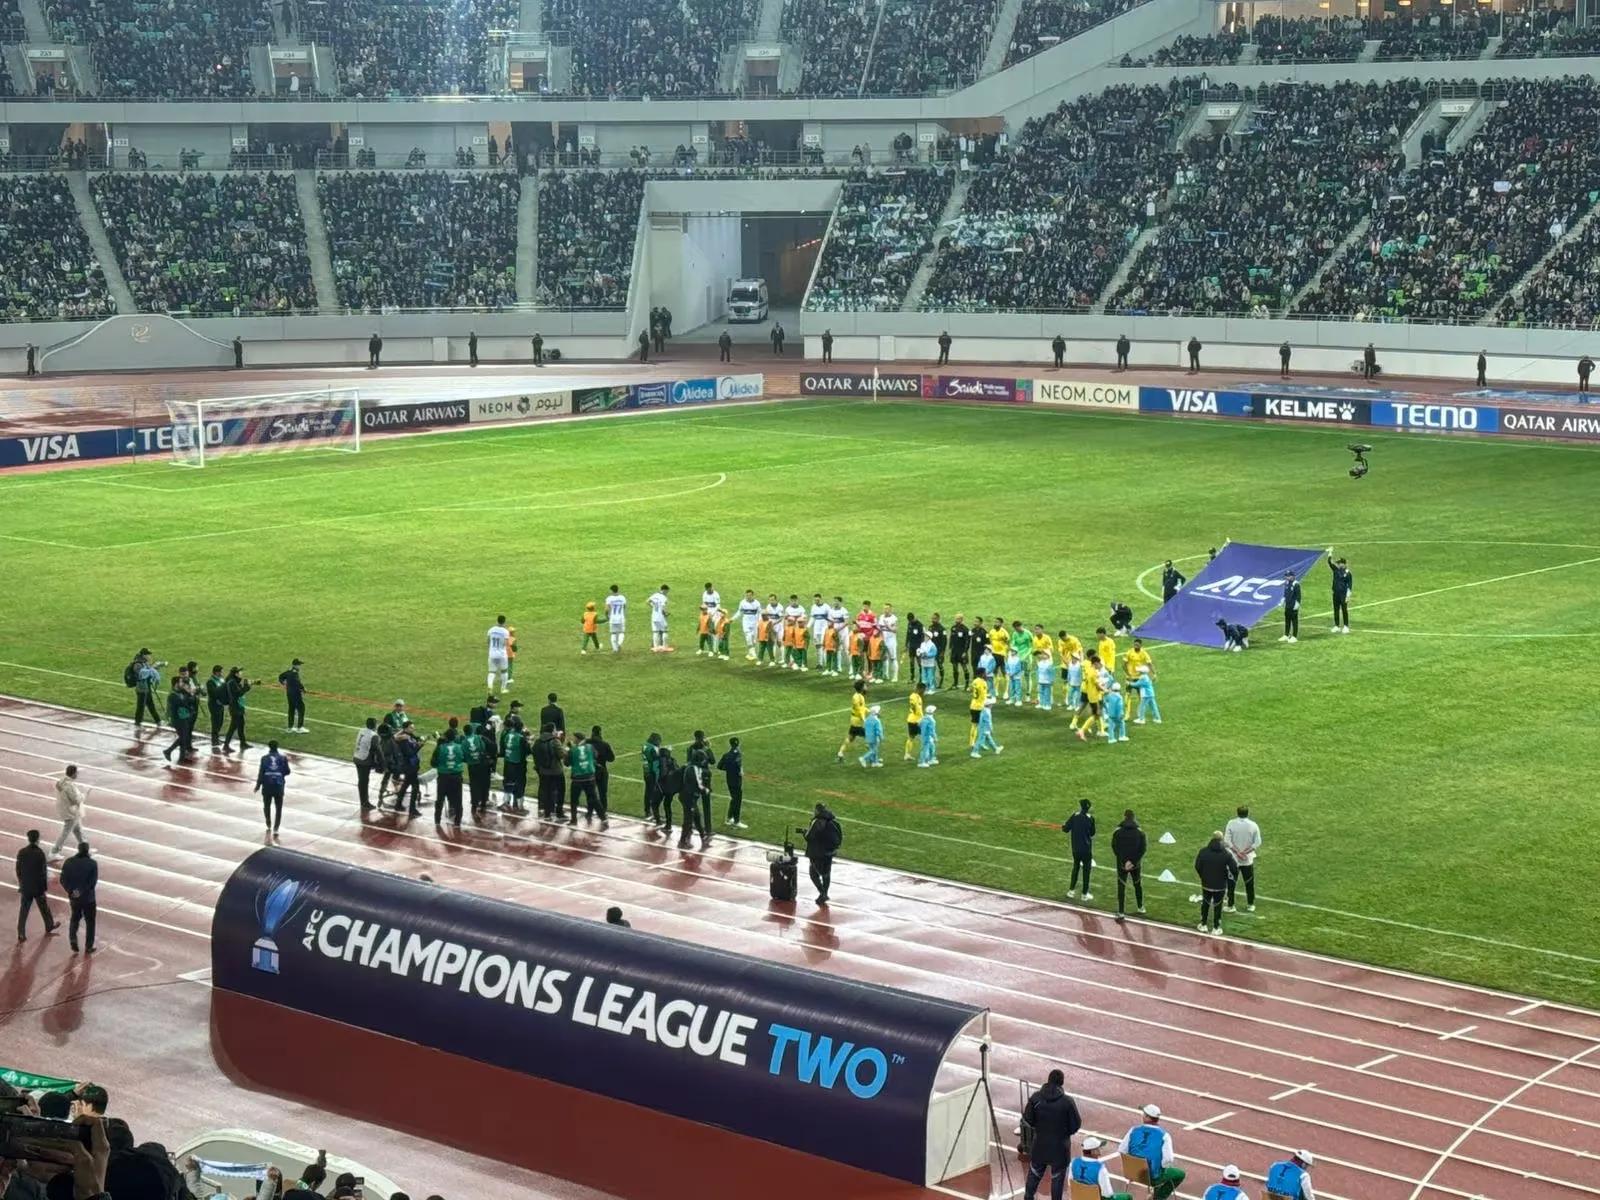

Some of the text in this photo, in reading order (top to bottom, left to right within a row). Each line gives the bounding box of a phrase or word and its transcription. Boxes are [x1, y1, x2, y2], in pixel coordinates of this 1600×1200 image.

[678, 384, 714, 401] Midea
[725, 380, 761, 398] Midea
[804, 376, 918, 392] QATAR AIRWAYS
[1041, 384, 1131, 405] NEOM.COM
[479, 402, 513, 414] NEOM
[1167, 389, 1218, 413] VISA
[1265, 398, 1338, 420] KELME
[364, 404, 466, 427] QATAR AIRWAYS
[1391, 403, 1478, 429] TECNO
[1503, 413, 1556, 431] QATAR
[17, 434, 81, 461] VISA
[1196, 575, 1285, 600] AFC
[302, 909, 324, 951] AFC
[318, 914, 571, 1014] CHAMPIONS
[572, 974, 758, 1066] LEAGUE
[768, 1023, 889, 1099] TWO
